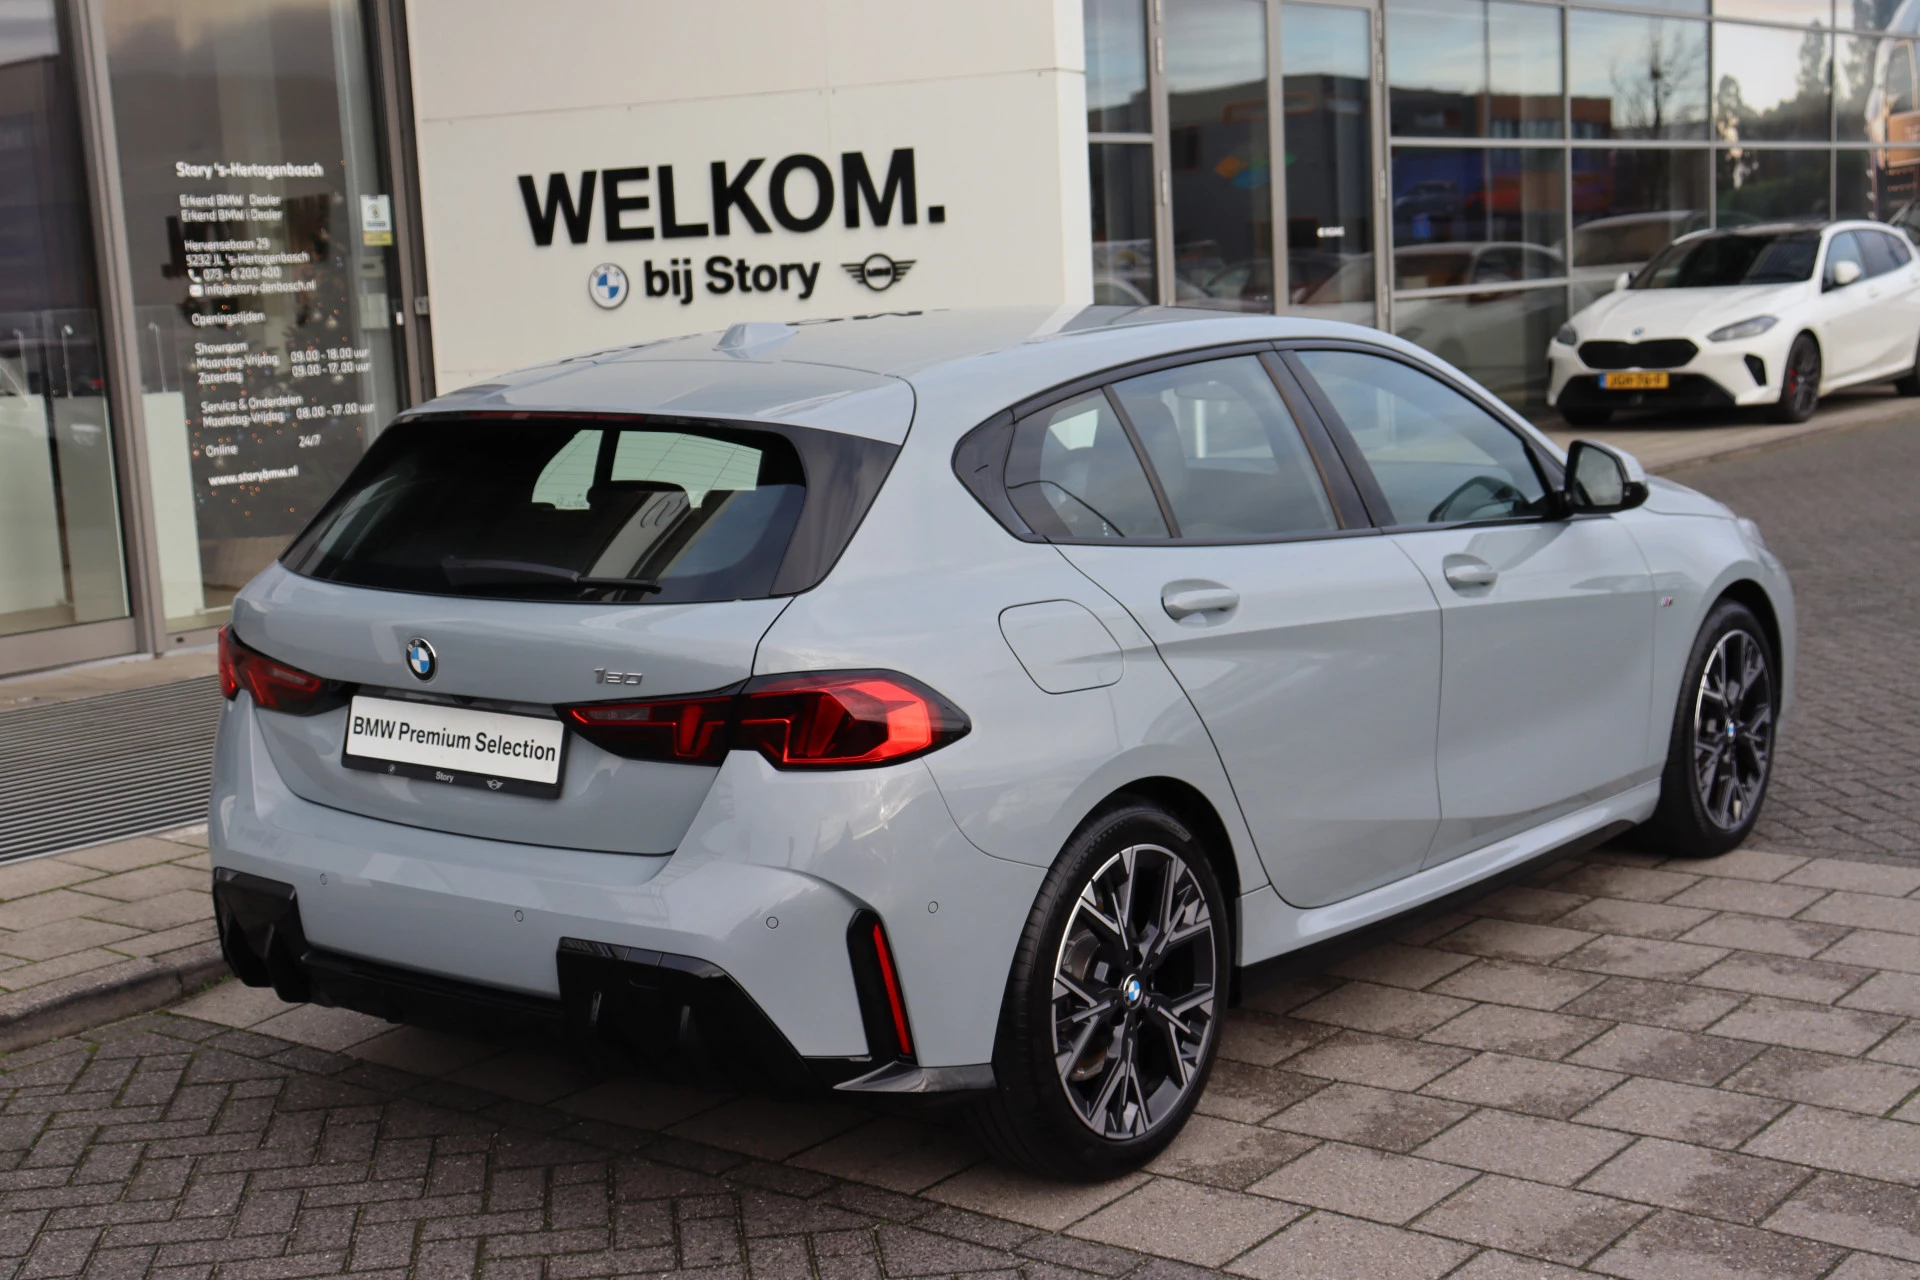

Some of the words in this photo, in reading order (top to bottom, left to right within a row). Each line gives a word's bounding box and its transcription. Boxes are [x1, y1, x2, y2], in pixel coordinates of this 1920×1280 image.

[175, 161, 213, 180] Story
[179, 194, 216, 207] Erkend
[216, 194, 244, 207] BMW
[249, 193, 281, 207] Dealer
[518, 147, 946, 247] WELKOM.
[181, 209, 217, 222] Erkend
[218, 208, 244, 221] BMW
[250, 208, 283, 221] Dealer
[256, 237, 271, 250] 29
[186, 254, 212, 267] 5232
[239, 267, 260, 280] 200
[261, 266, 282, 279] 400
[644, 257, 694, 305] bij
[705, 255, 821, 301] Story
[194, 342, 248, 355] Showroom
[291, 350, 320, 363] 09.00
[326, 347, 353, 360] 18.00
[353, 348, 369, 359] uur
[198, 371, 244, 385] Zaterdag
[292, 364, 321, 378] 09.00
[327, 361, 355, 375] 17.00
[355, 362, 371, 373] uur
[201, 400, 238, 414] Service
[238, 399, 248, 411] &
[248, 395, 304, 410] Onderdelen
[332, 403, 359, 417] 17.00
[205, 444, 239, 457] Online
[298, 434, 322, 448] 24/7
[208, 465, 299, 486] www.storybmw.nl
[594, 667, 643, 686] 120
[353, 715, 397, 739] BMW
[398, 721, 471, 750] Premium
[474, 731, 557, 762] Selection
[435, 770, 454, 784] Story
